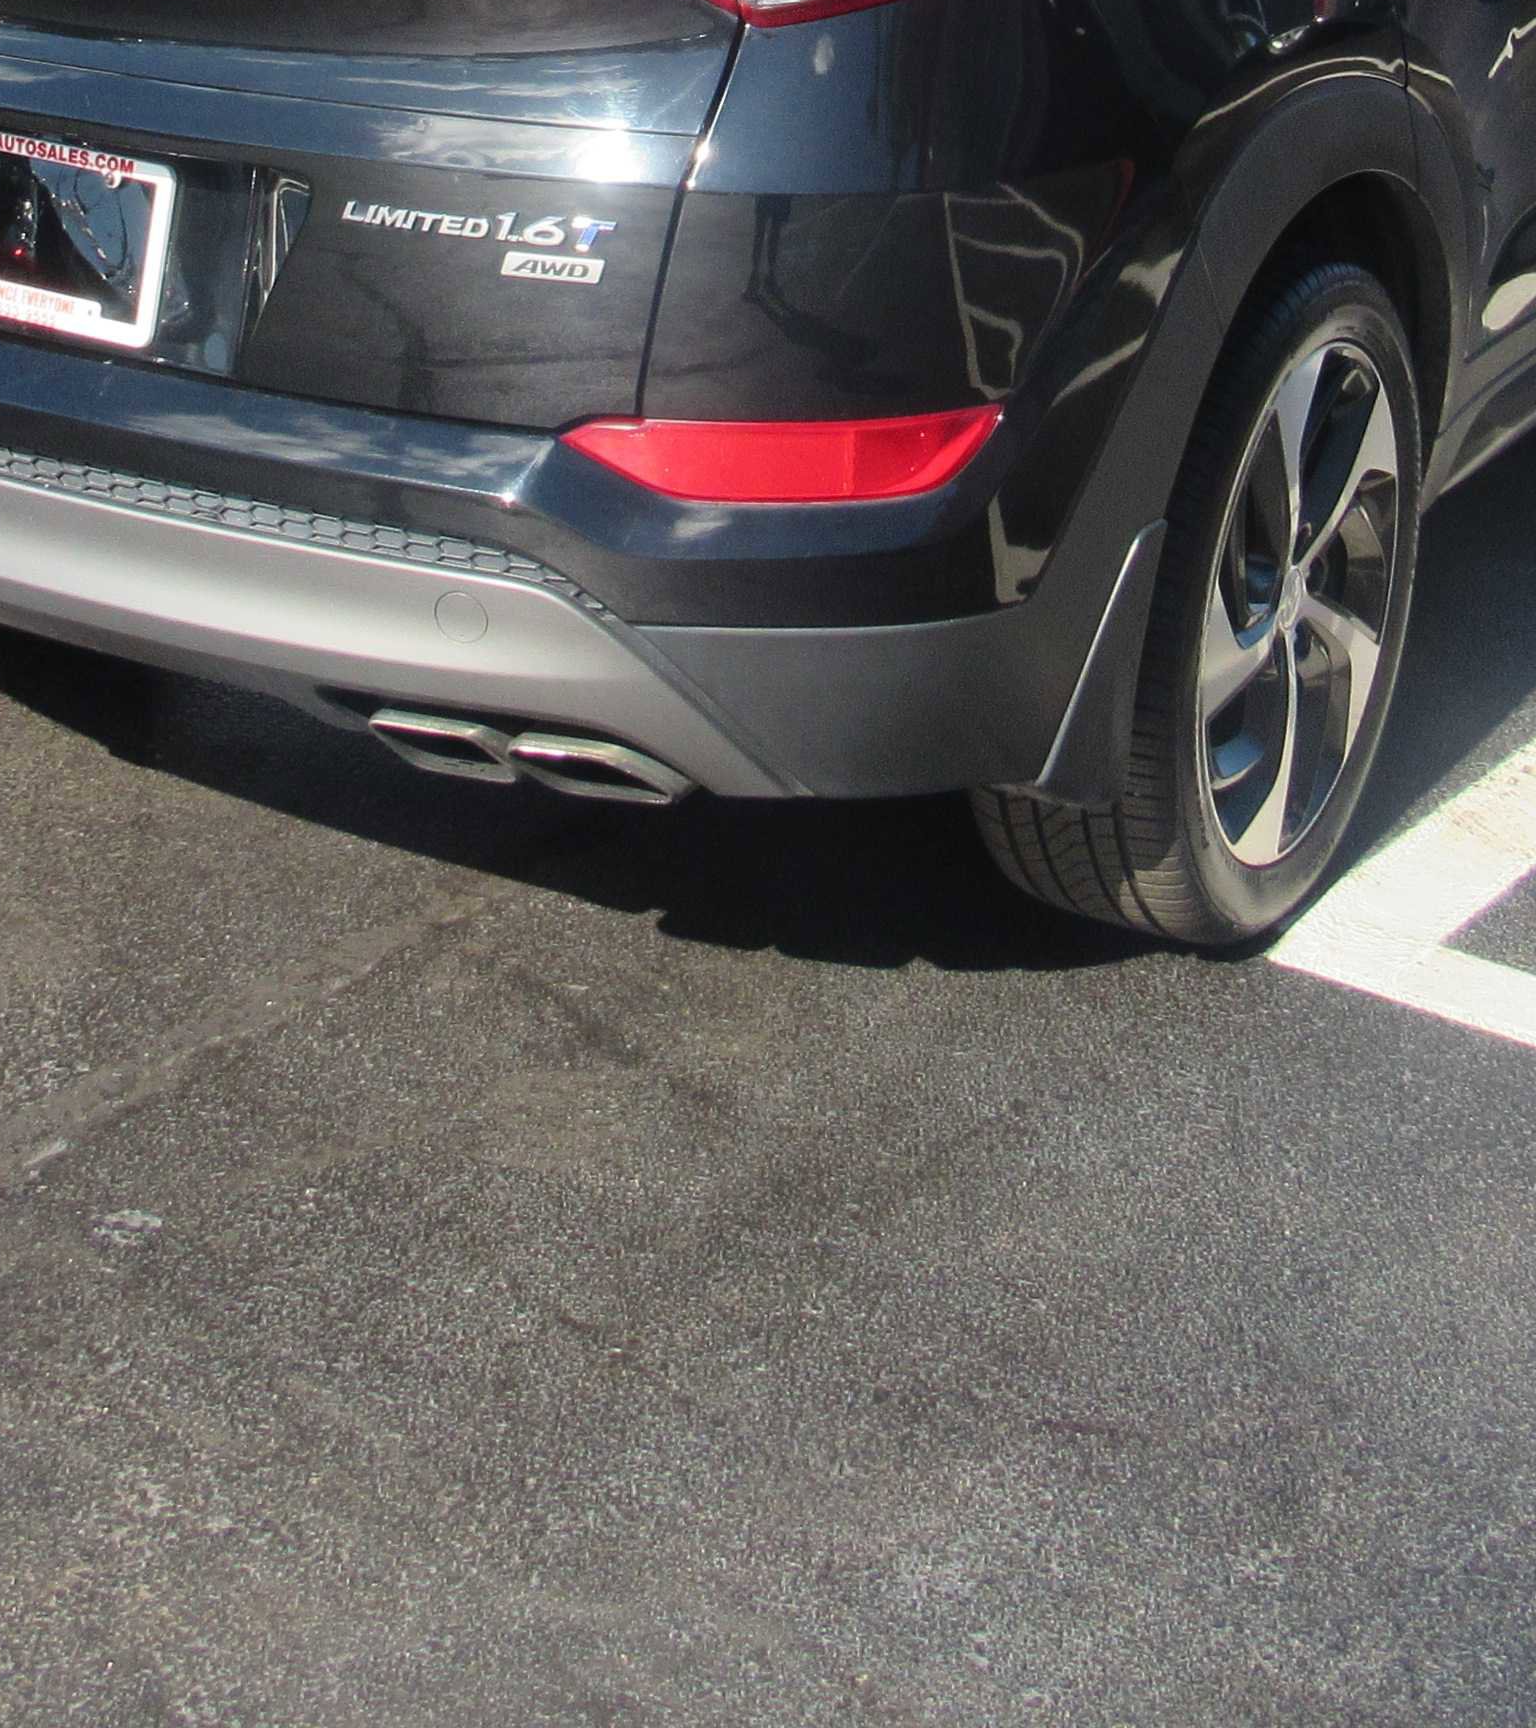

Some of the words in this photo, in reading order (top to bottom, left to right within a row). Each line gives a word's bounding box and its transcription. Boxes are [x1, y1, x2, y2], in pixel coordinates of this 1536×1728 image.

[341, 200, 490, 239] LIMITED
[512, 258, 591, 280] AWD
[21, 288, 75, 315] EVERYONE
